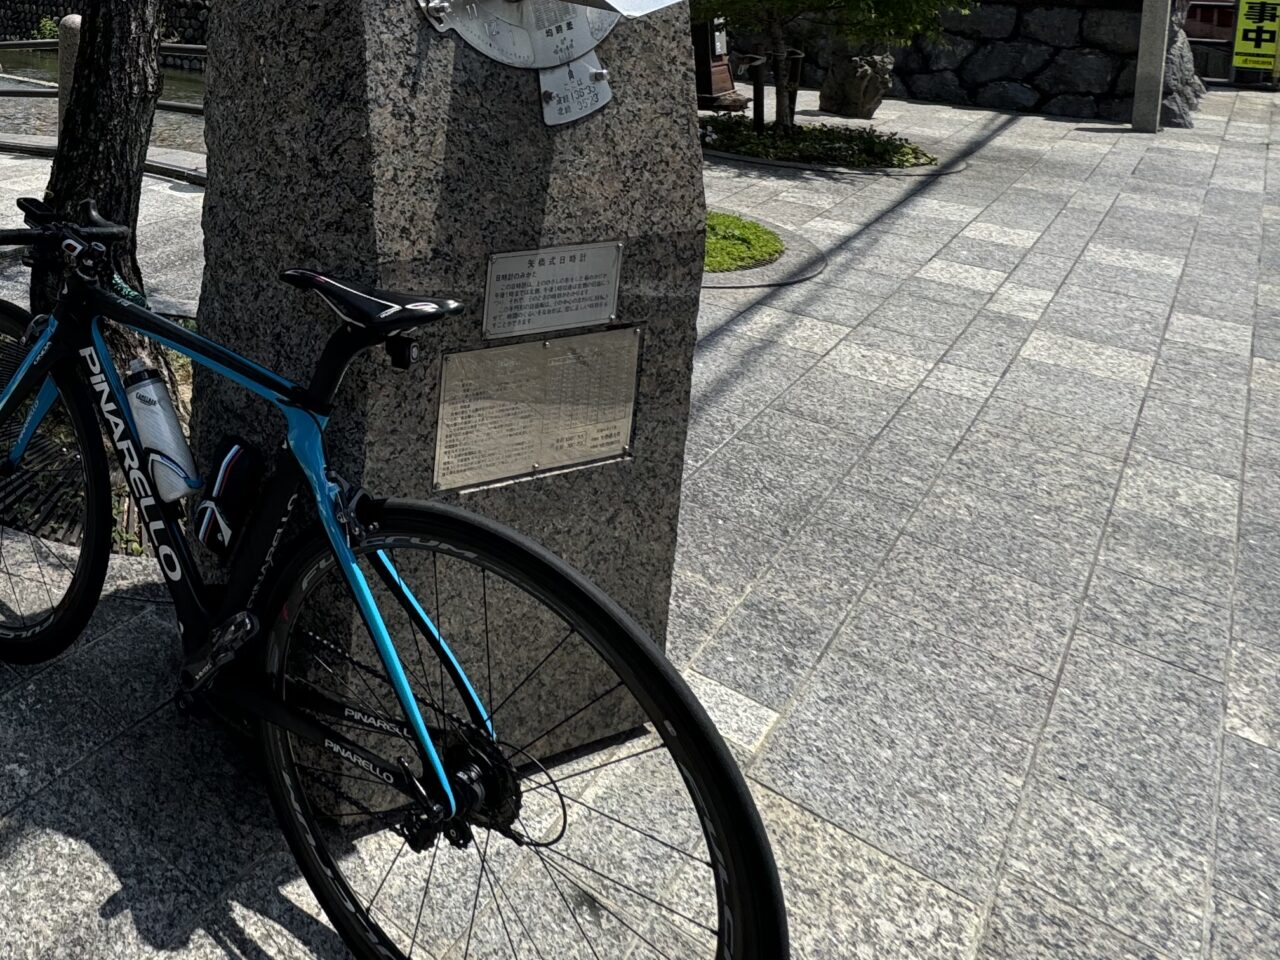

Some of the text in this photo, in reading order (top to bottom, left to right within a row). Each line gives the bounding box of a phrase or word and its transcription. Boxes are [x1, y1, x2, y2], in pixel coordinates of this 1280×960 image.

[465, 3, 479, 20] 11
[484, 21, 499, 37] 12
[81, 346, 182, 582] PINARELLO
[324, 738, 395, 784] PINARELLO
